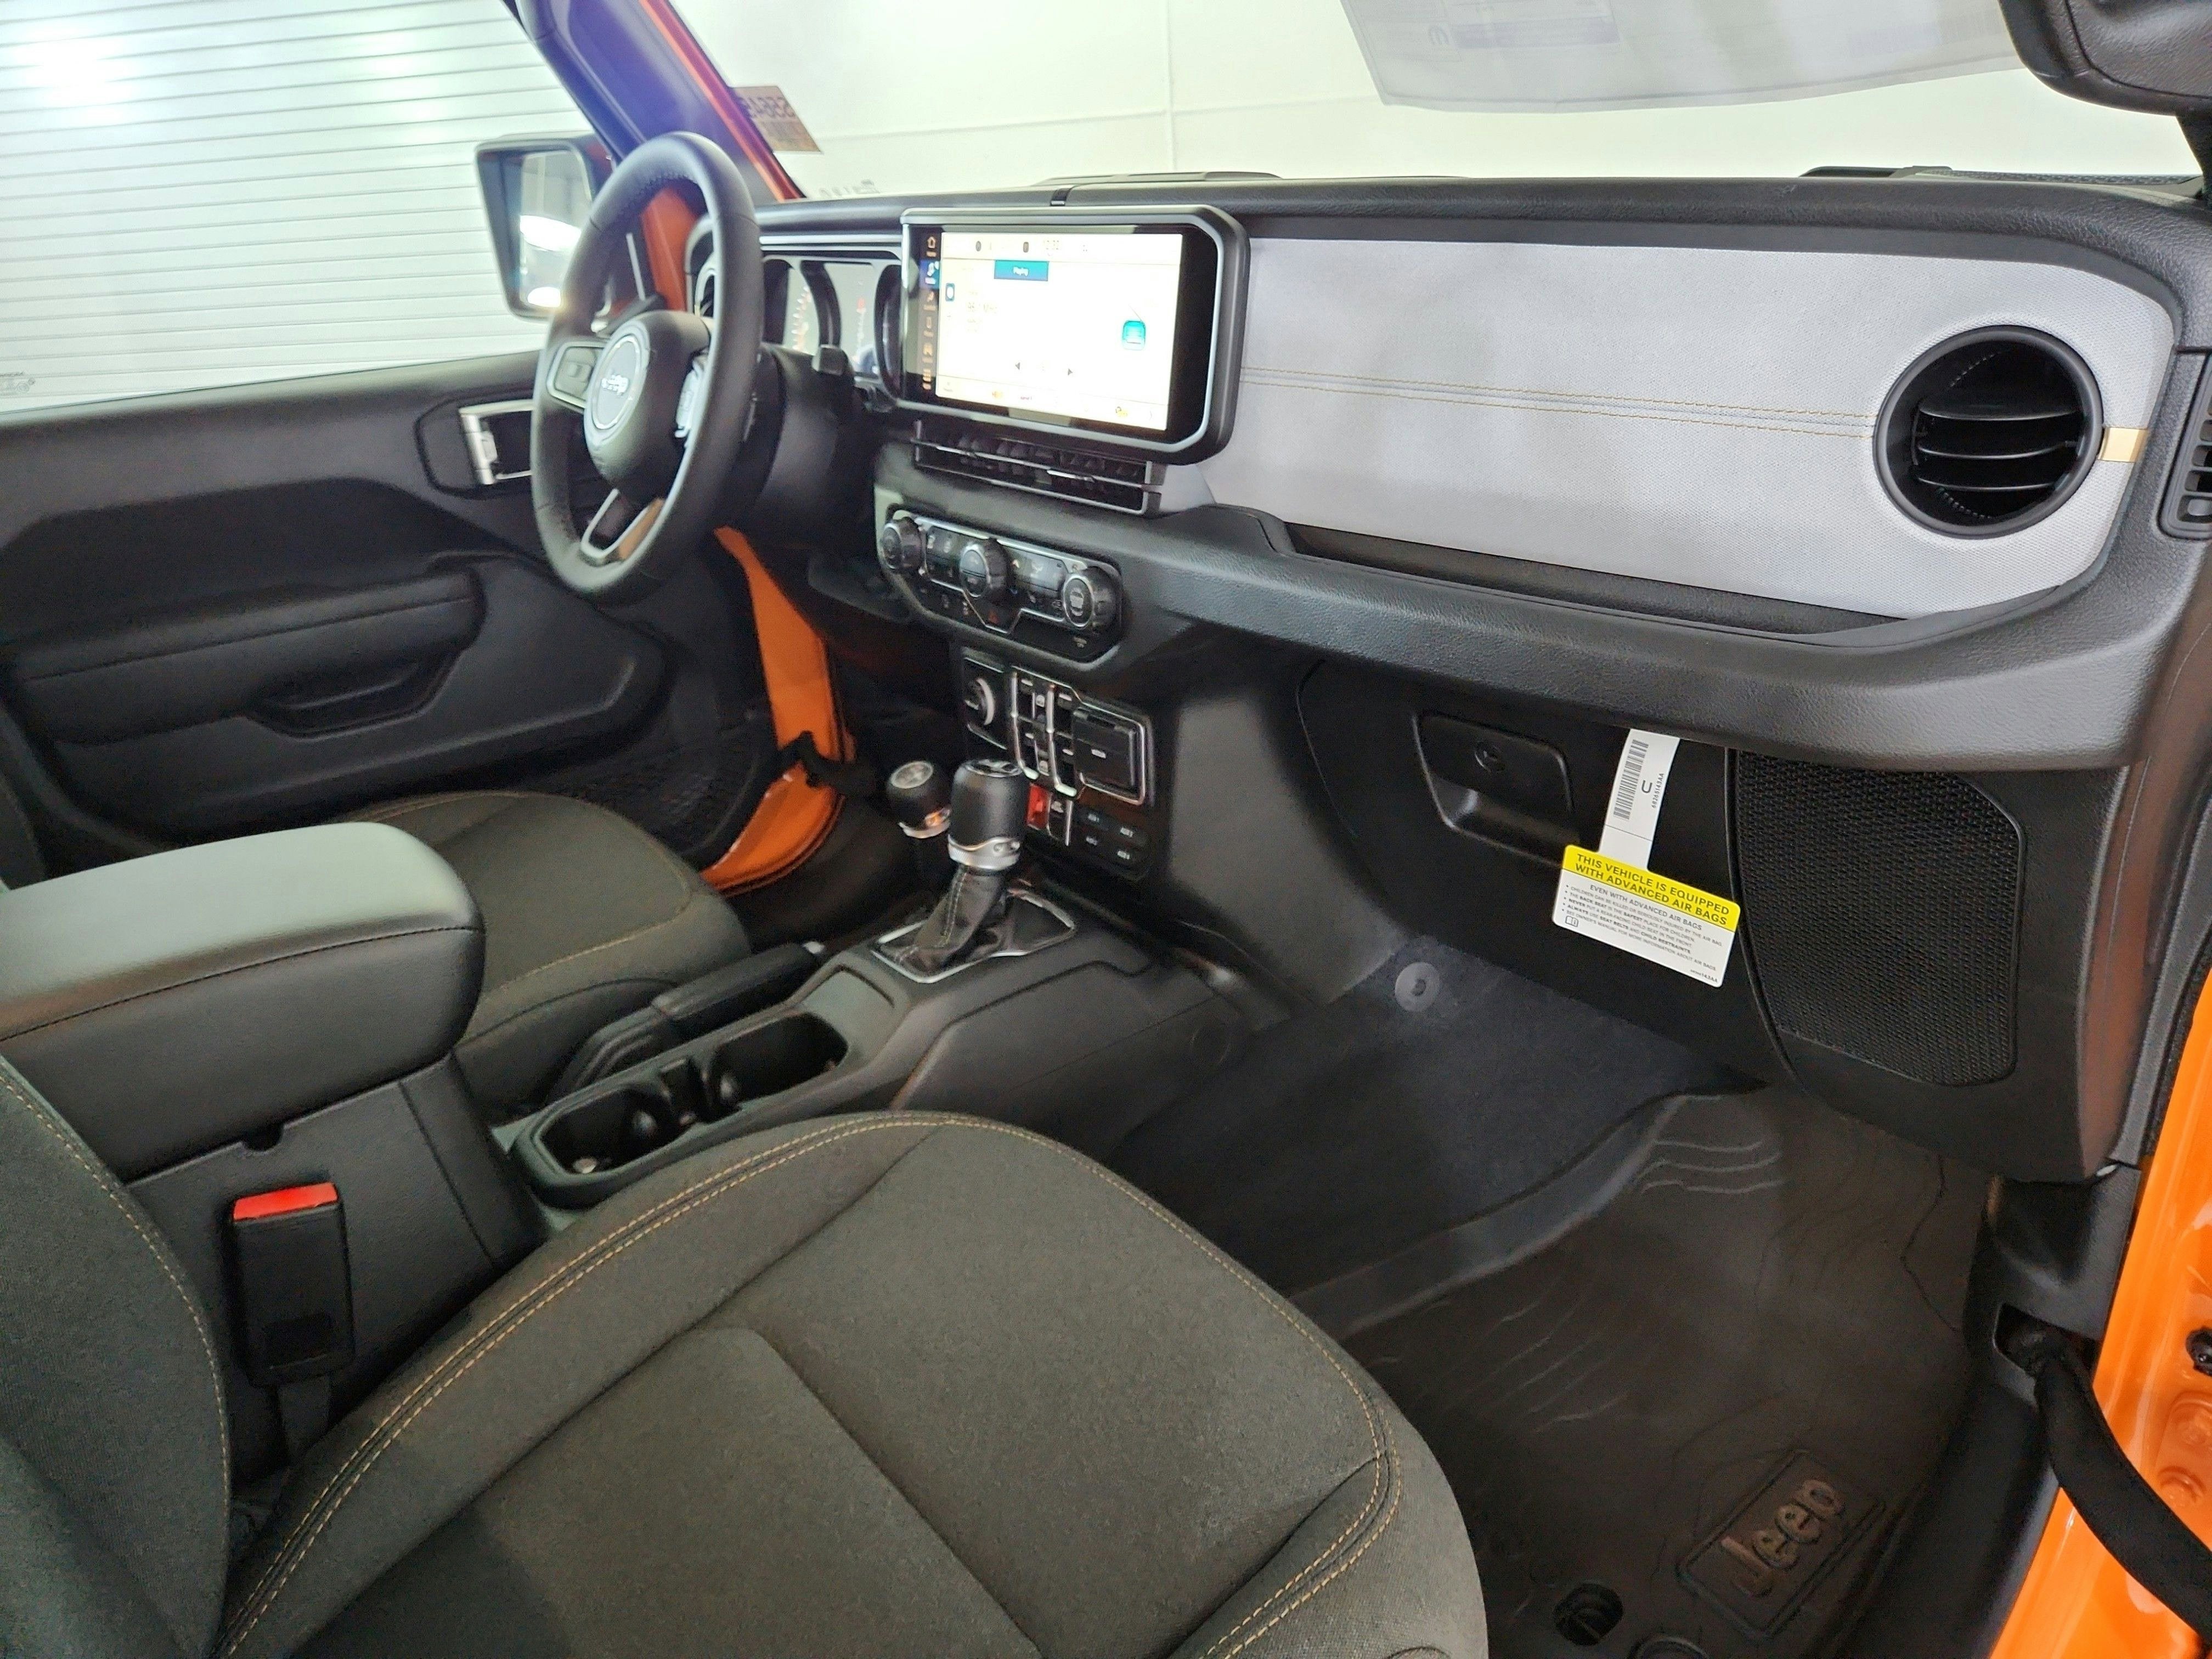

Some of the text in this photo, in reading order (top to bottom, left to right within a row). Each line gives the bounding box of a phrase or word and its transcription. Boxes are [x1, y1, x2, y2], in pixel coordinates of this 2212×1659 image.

[1567, 904, 1588, 915] ALWAYS
[1568, 898, 1585, 907] NEVER
[1576, 863, 1726, 924] WITH ADVANCED AIR BAGS
[1577, 853, 1729, 915] THIS VEHICLE IS EQUIPPED
[1590, 884, 1607, 895] EVEN
[1610, 891, 1627, 901] WITH
[1629, 899, 1667, 916] ADVANCED
[1683, 918, 1702, 930] BAGS
[1720, 1479, 1845, 1598] Jeep
